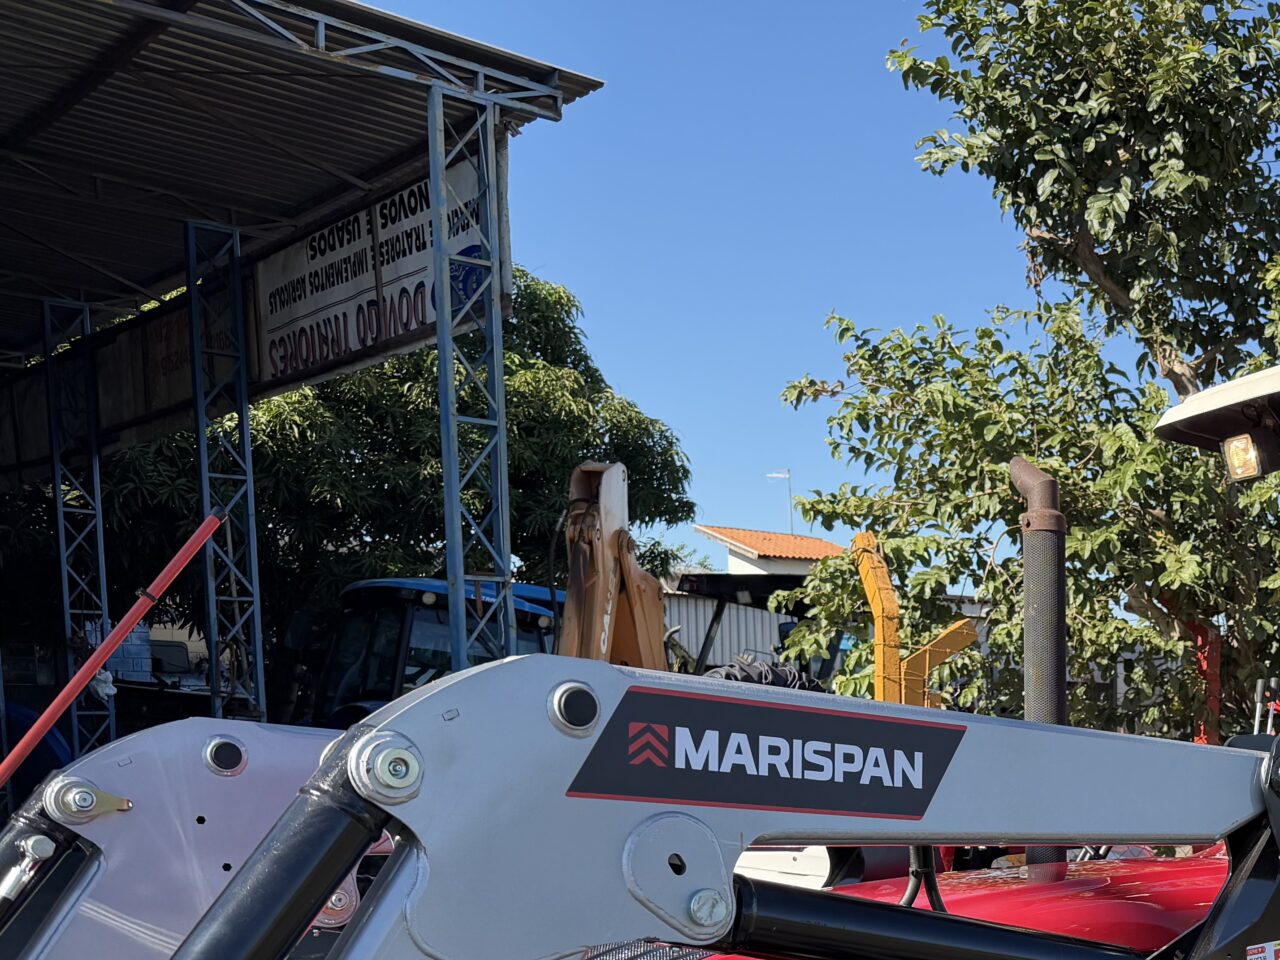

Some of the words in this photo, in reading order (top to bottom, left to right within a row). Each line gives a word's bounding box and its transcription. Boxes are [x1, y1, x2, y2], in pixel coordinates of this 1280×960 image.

[379, 220, 427, 269] TRATORES
[268, 273, 307, 316] AGRÍCOLAS
[309, 247, 369, 297] IMPLEMENTOS
[268, 311, 353, 379] TRATORES
[675, 726, 923, 790] MARISPAN
